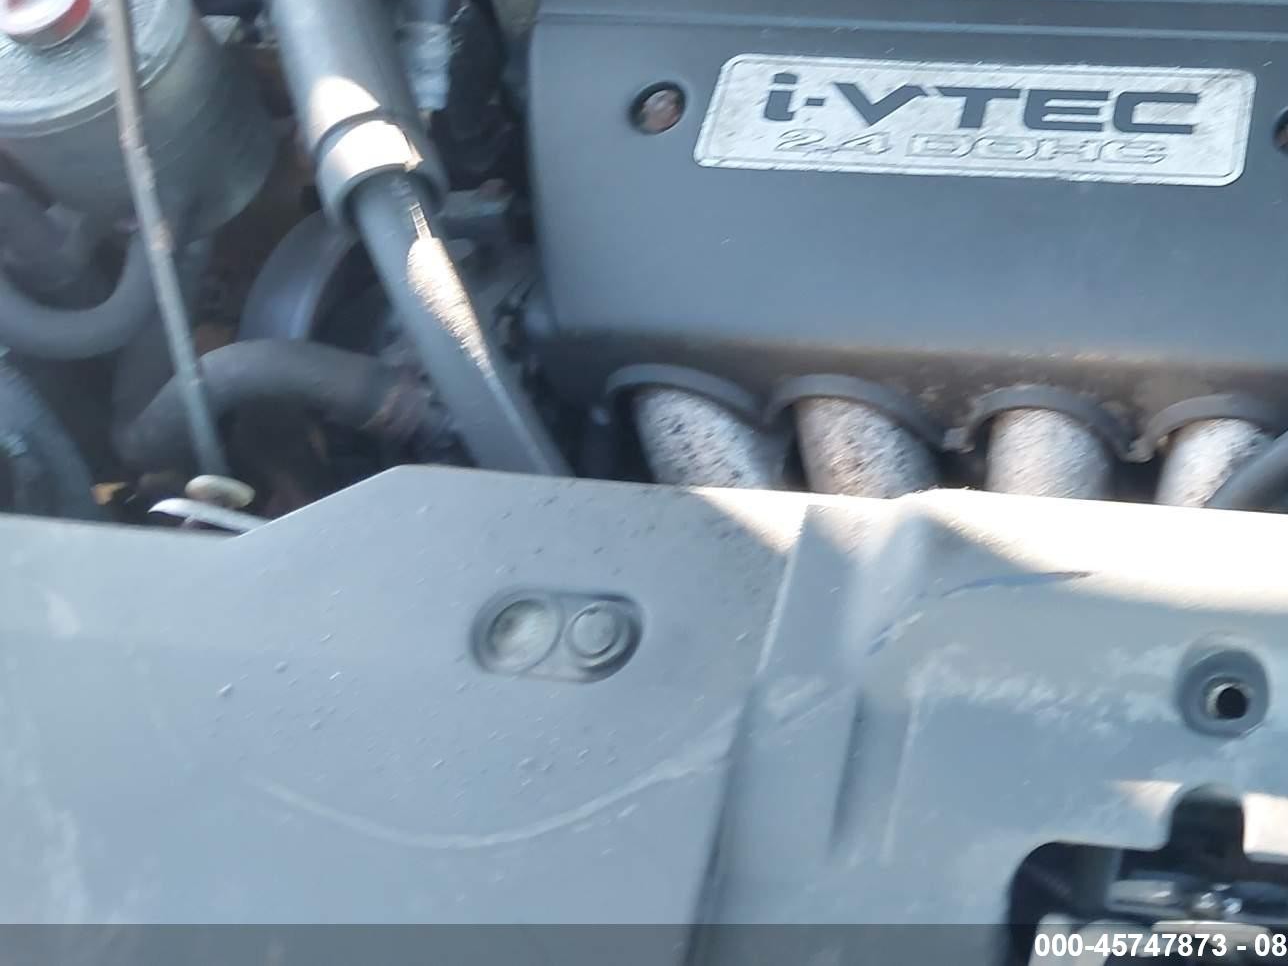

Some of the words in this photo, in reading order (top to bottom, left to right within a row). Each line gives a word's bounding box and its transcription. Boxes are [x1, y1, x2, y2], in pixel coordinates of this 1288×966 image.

[763, 71, 1200, 134] i-VTEC
[773, 127, 894, 159] 2.4
[904, 132, 1168, 164] DOHC
